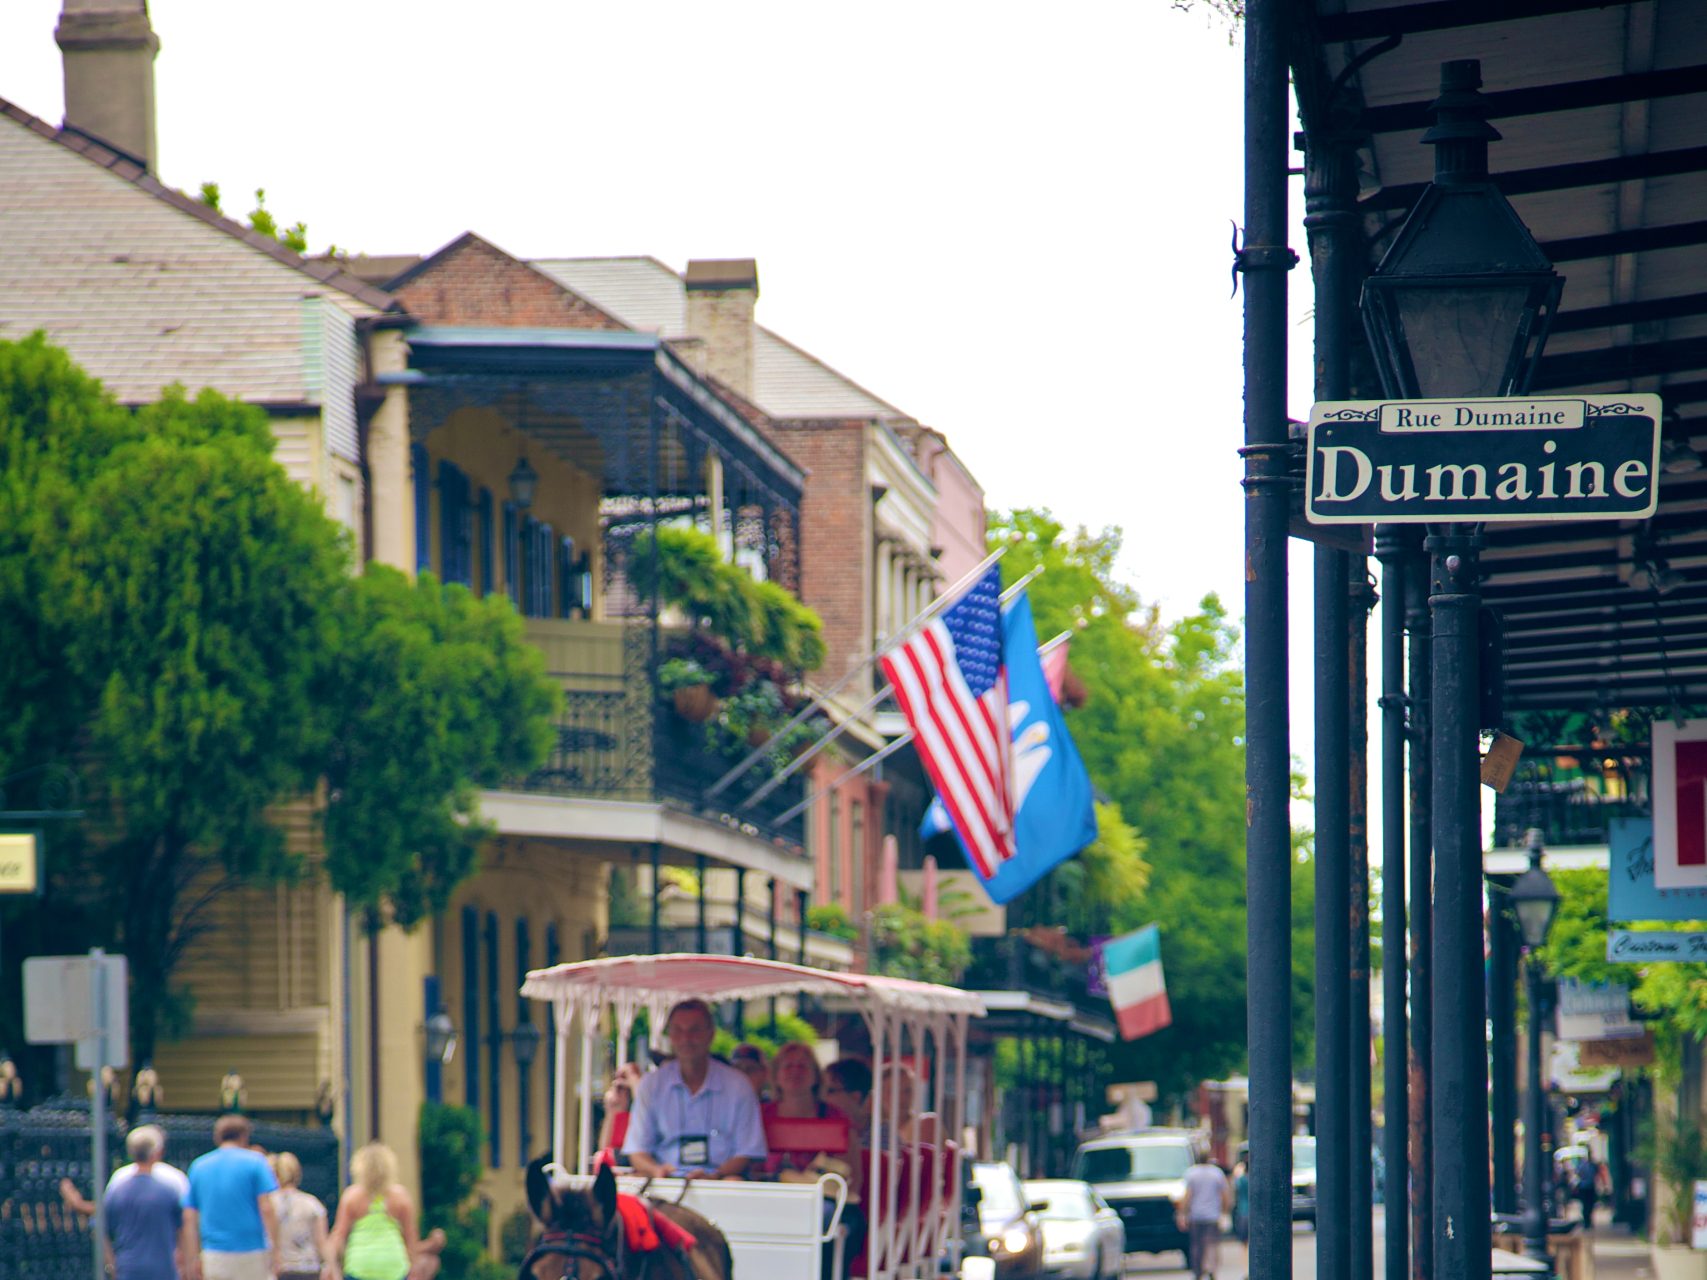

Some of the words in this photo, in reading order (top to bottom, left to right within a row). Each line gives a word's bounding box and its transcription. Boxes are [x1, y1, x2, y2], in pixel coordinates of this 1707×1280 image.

[1396, 407, 1442, 428] Rue
[1454, 404, 1567, 427] Dumaine
[1314, 440, 1648, 502] Dumaine
